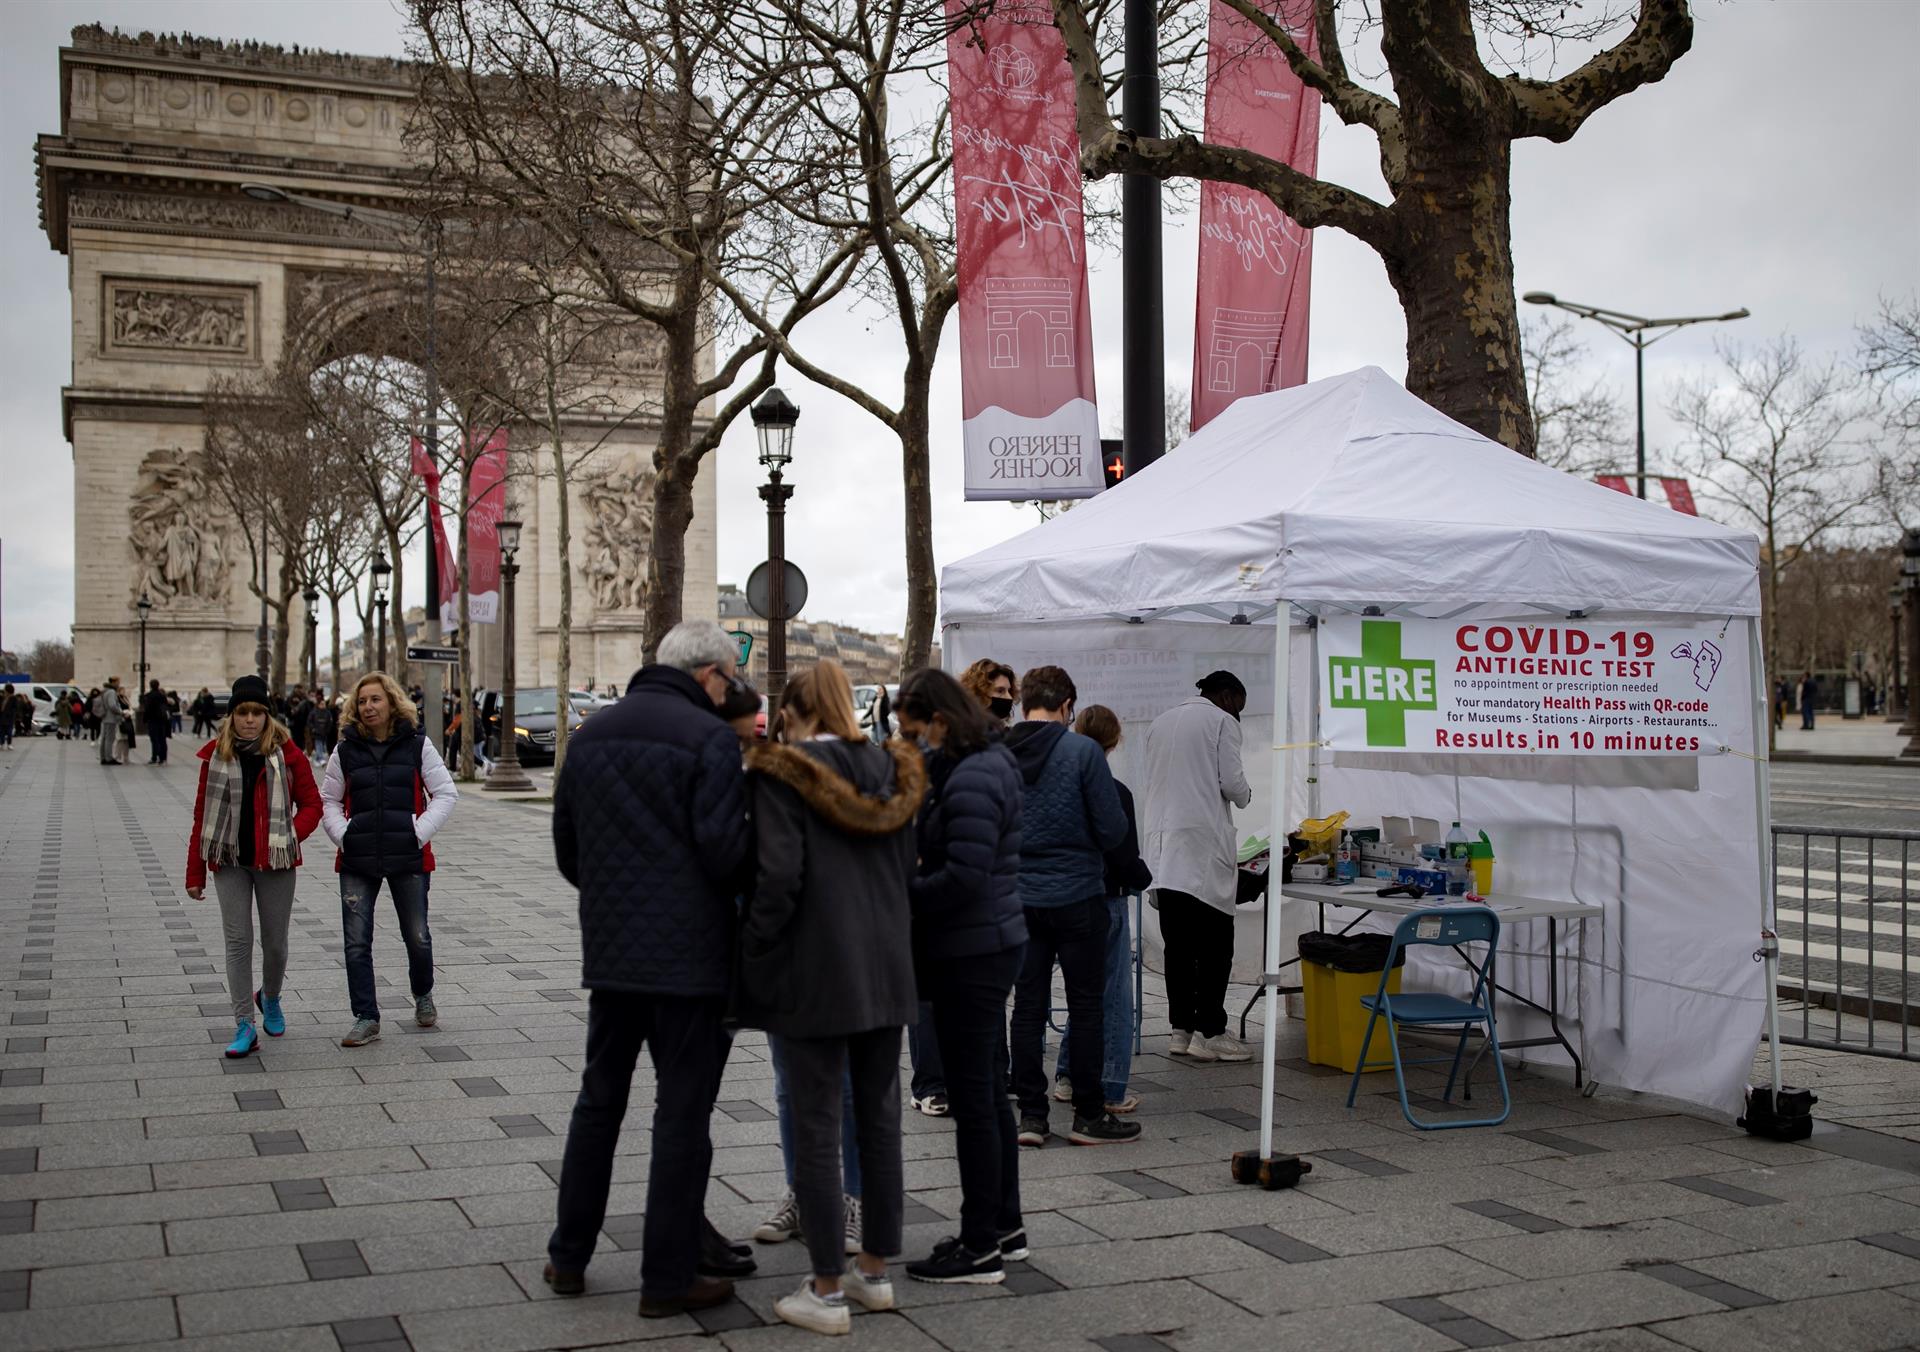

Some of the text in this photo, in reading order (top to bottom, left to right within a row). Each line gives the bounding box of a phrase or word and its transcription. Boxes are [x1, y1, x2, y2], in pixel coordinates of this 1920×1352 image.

[1455, 625, 1655, 658] COVID-19
[1455, 655, 1655, 678] ANTIGENIC TEST
[1333, 664, 1433, 702] HERE
[1454, 679, 1658, 694] no appointment or prescription needed
[1455, 695, 1709, 713] Your mandatory Health Pass with QR-code
[1447, 711, 1464, 722] for
[1468, 712, 1522, 723] Museums
[1532, 713, 1578, 724] Stations
[1588, 714, 1633, 727] Airports
[1644, 715, 1718, 727] Restaurants...
[1436, 728, 1700, 751] Results in 10 minutes
